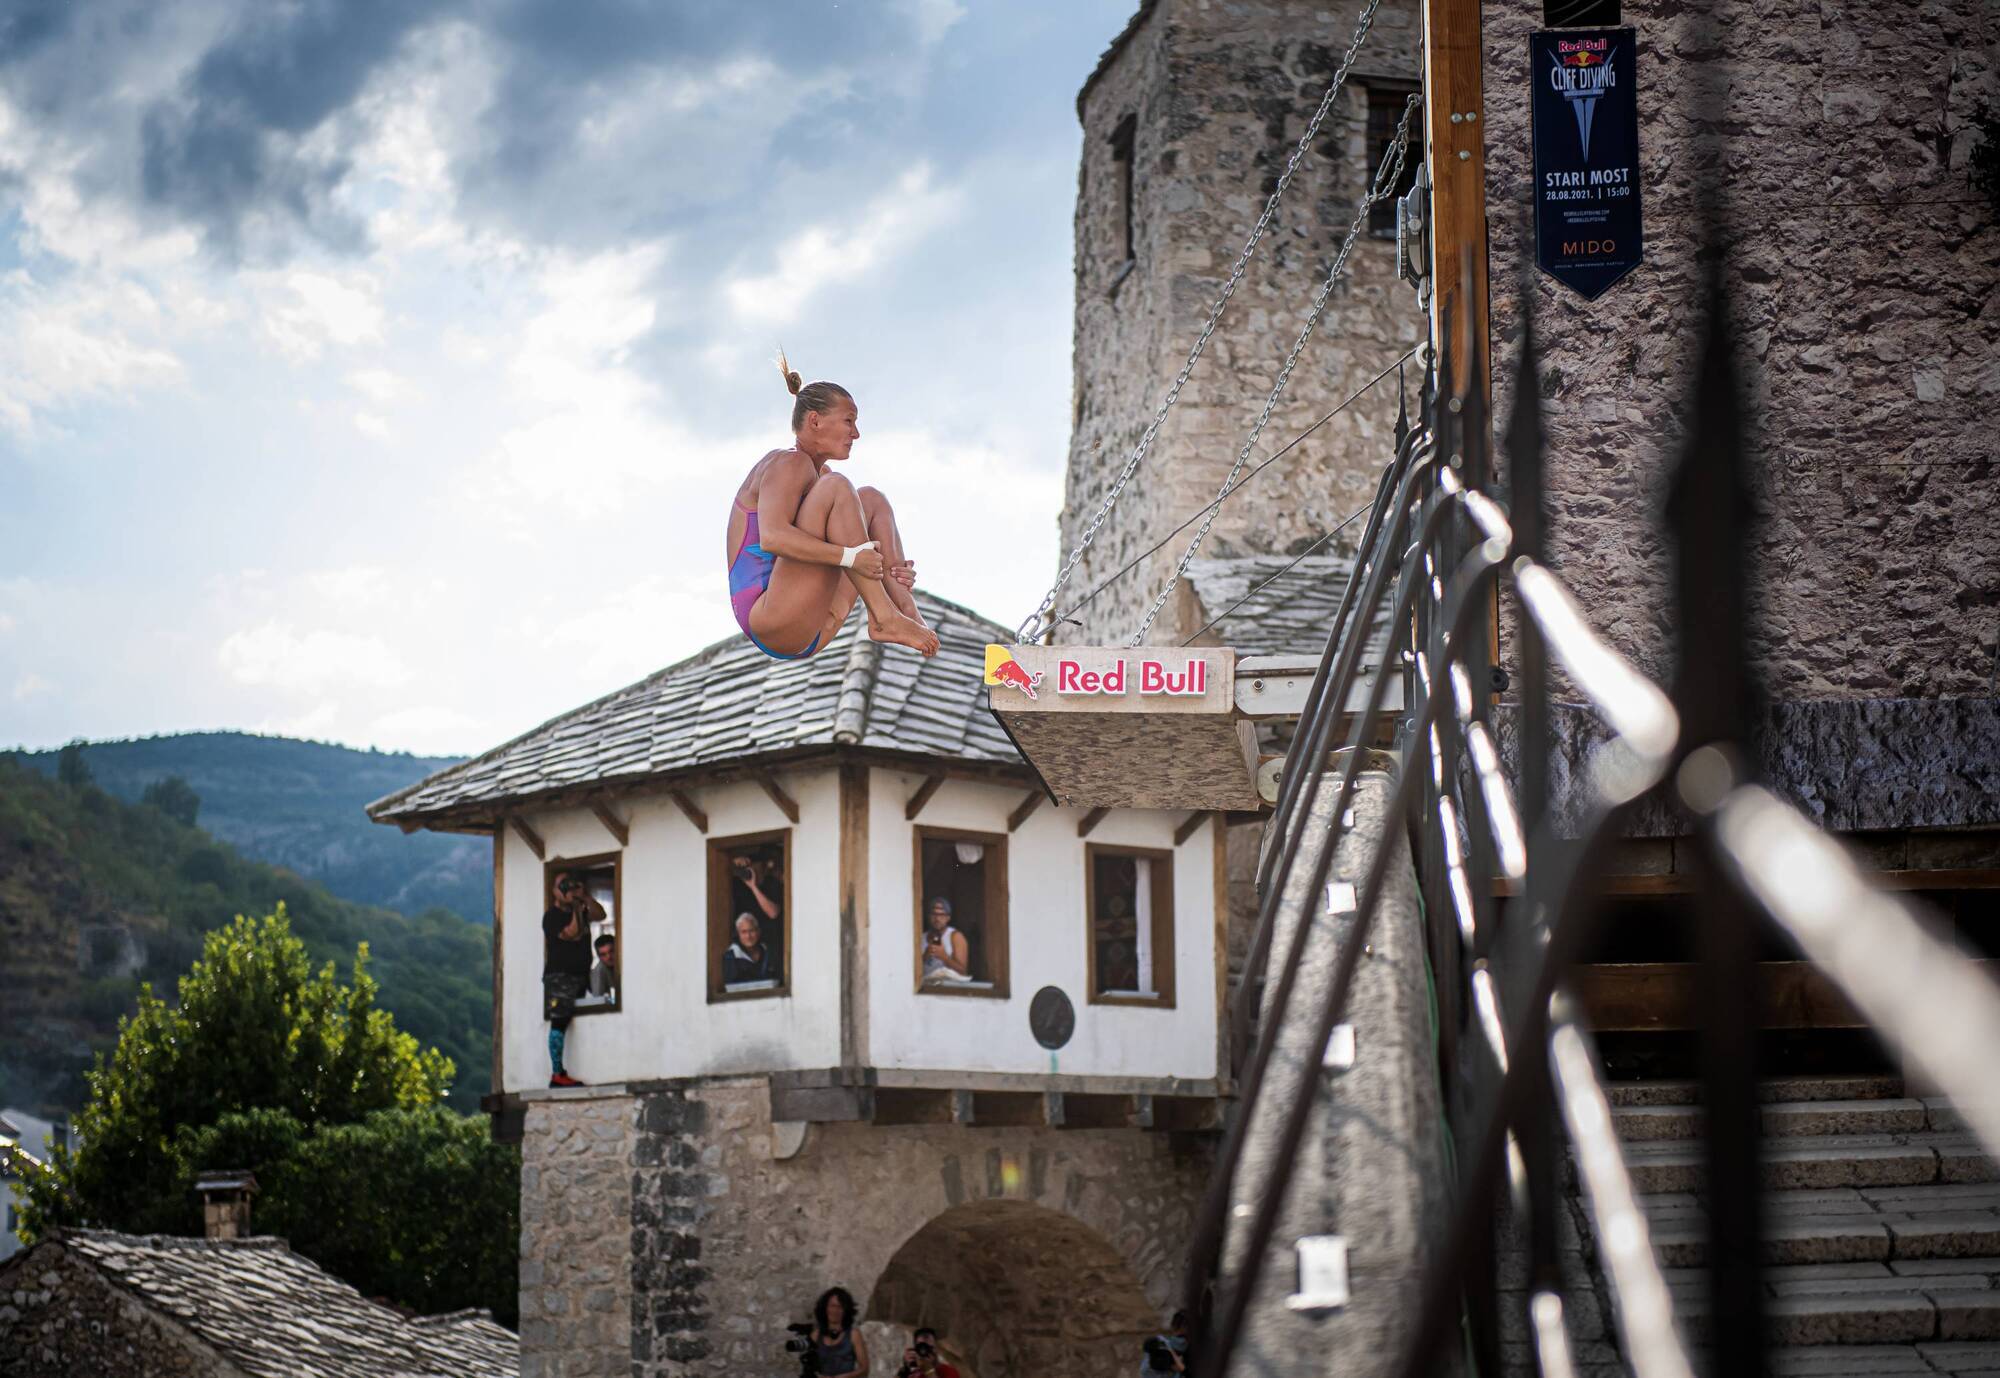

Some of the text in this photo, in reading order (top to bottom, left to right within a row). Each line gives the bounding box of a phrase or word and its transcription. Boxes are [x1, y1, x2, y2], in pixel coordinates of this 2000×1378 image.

[1558, 38, 1607, 52] Red Bull
[1551, 63, 1616, 91] CLIFF DIVING
[1546, 168, 1629, 187] STARI MOST
[1546, 190, 1594, 200] 28.08.2021.
[1607, 186, 1630, 197] 15:00
[1563, 239, 1616, 255] MIDO
[1058, 659, 1207, 695] Red Bull
